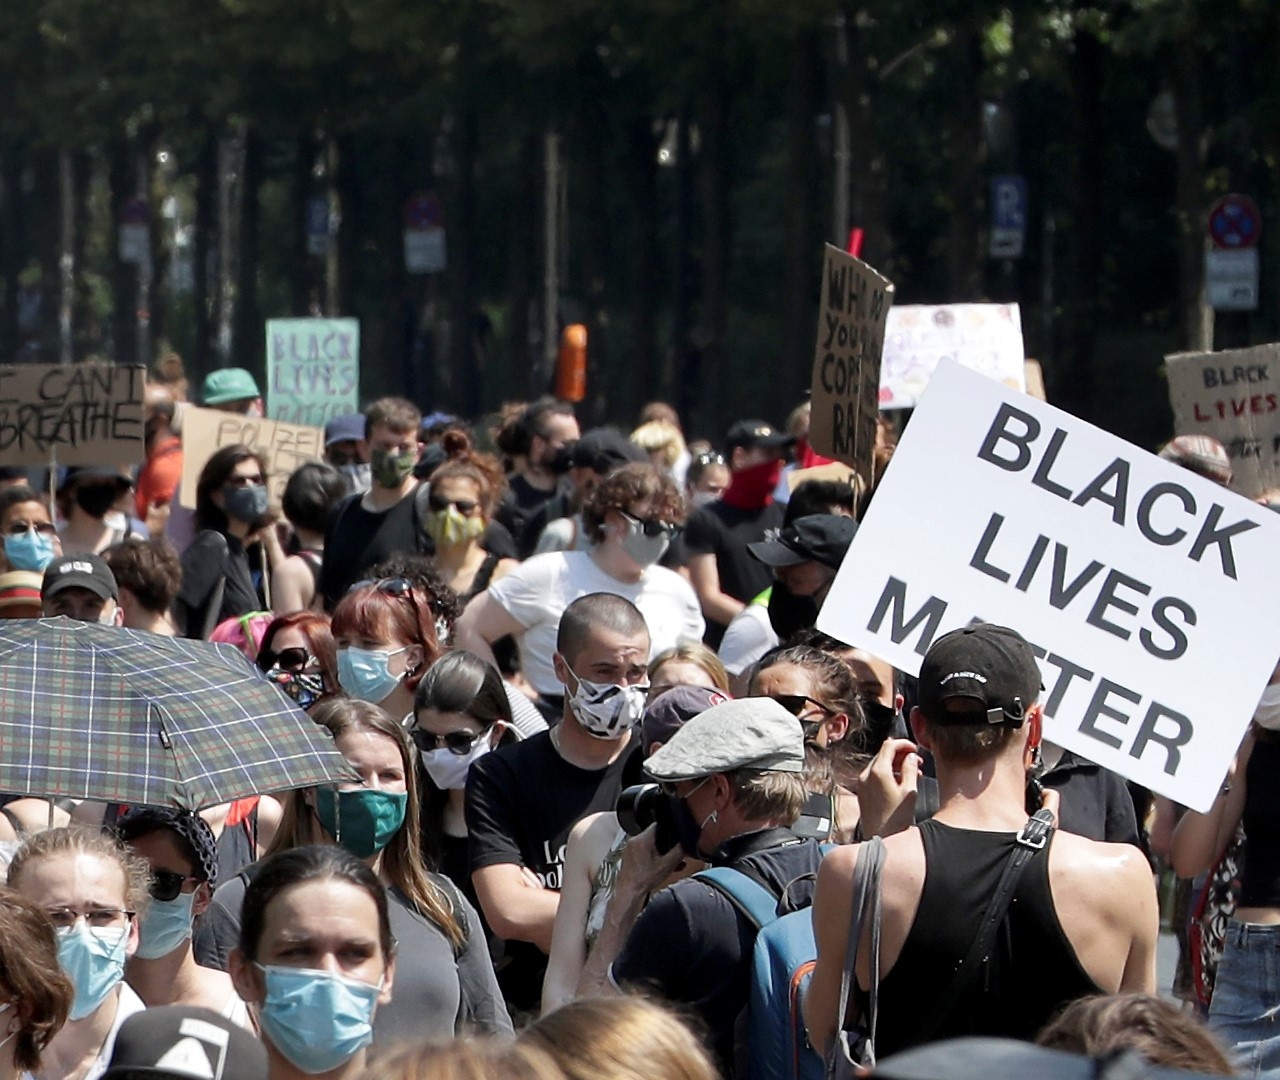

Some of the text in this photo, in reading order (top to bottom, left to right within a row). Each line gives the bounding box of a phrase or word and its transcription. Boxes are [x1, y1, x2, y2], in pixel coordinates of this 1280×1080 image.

[273, 333, 353, 362] BLACK
[37, 363, 146, 399] CAN'T
[274, 363, 356, 396] LIVES
[1193, 393, 1278, 423] LIVES
[976, 402, 1261, 581] BLACK
[969, 513, 1197, 660] LIVES
